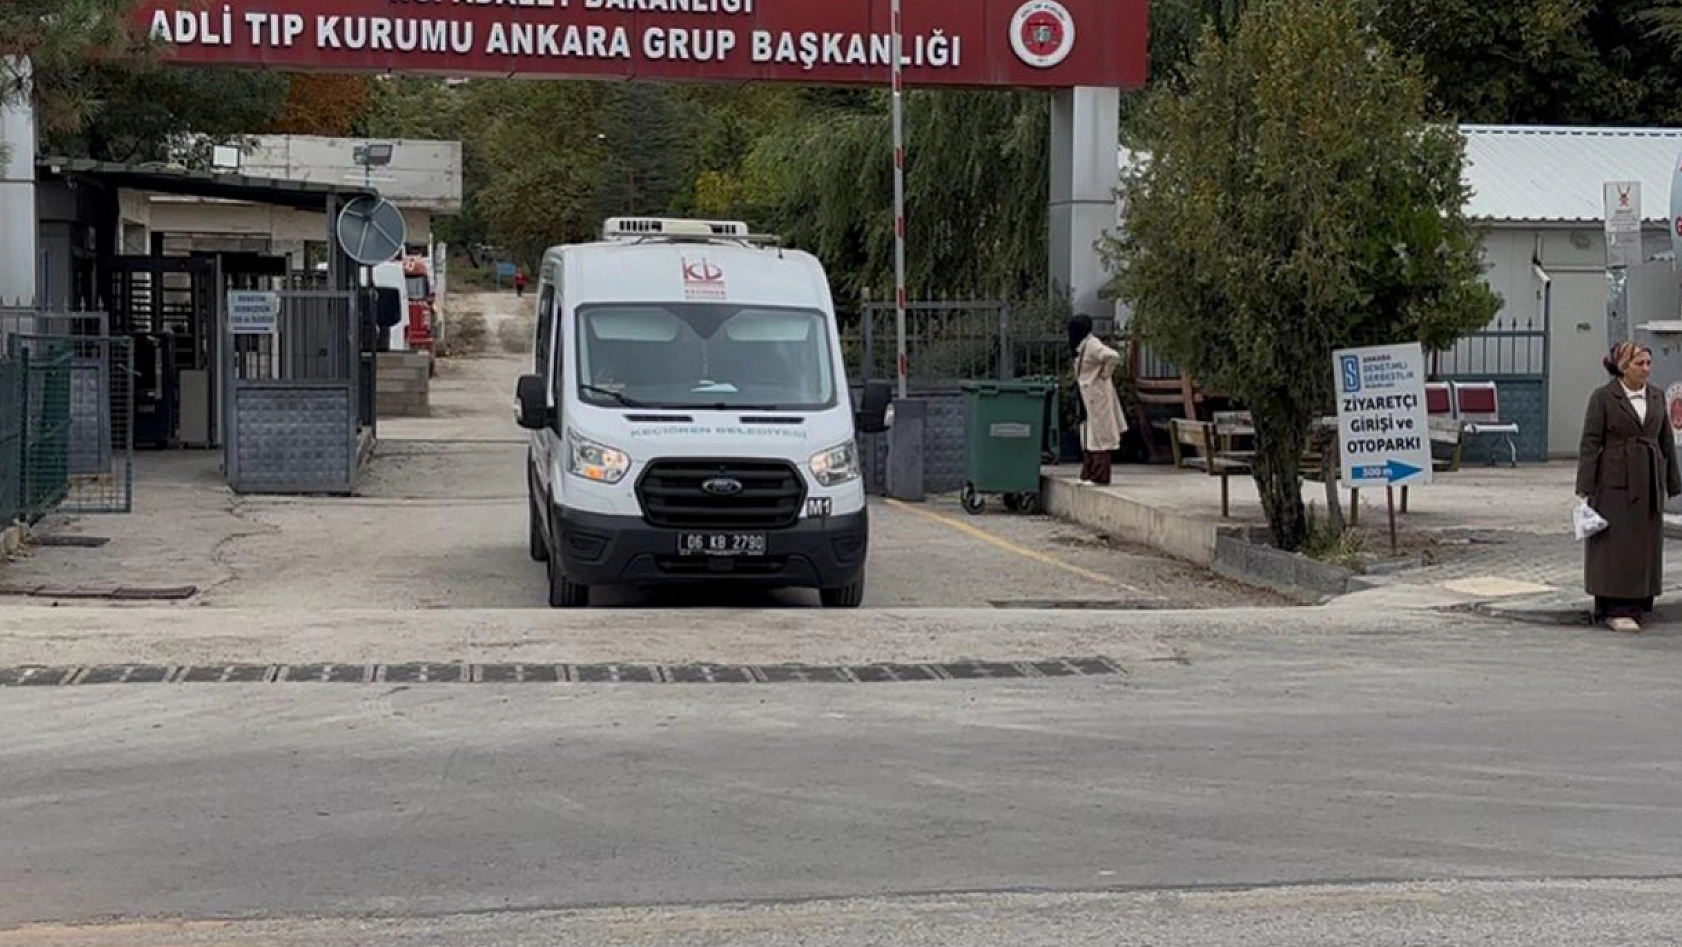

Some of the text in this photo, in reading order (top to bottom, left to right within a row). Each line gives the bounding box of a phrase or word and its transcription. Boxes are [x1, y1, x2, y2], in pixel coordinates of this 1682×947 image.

[149, 4, 232, 44] ADLİ
[245, 13, 302, 46] TIP
[317, 16, 473, 53] KURUMU
[485, 23, 631, 58] ANKARA
[643, 28, 736, 61] GRUP
[1351, 413, 1414, 434] GİRİŞİ ve
[1347, 436, 1421, 453] OTOPARKI
[808, 499, 831, 515] M1
[687, 533, 703, 549] 06
[709, 534, 726, 549] KB
